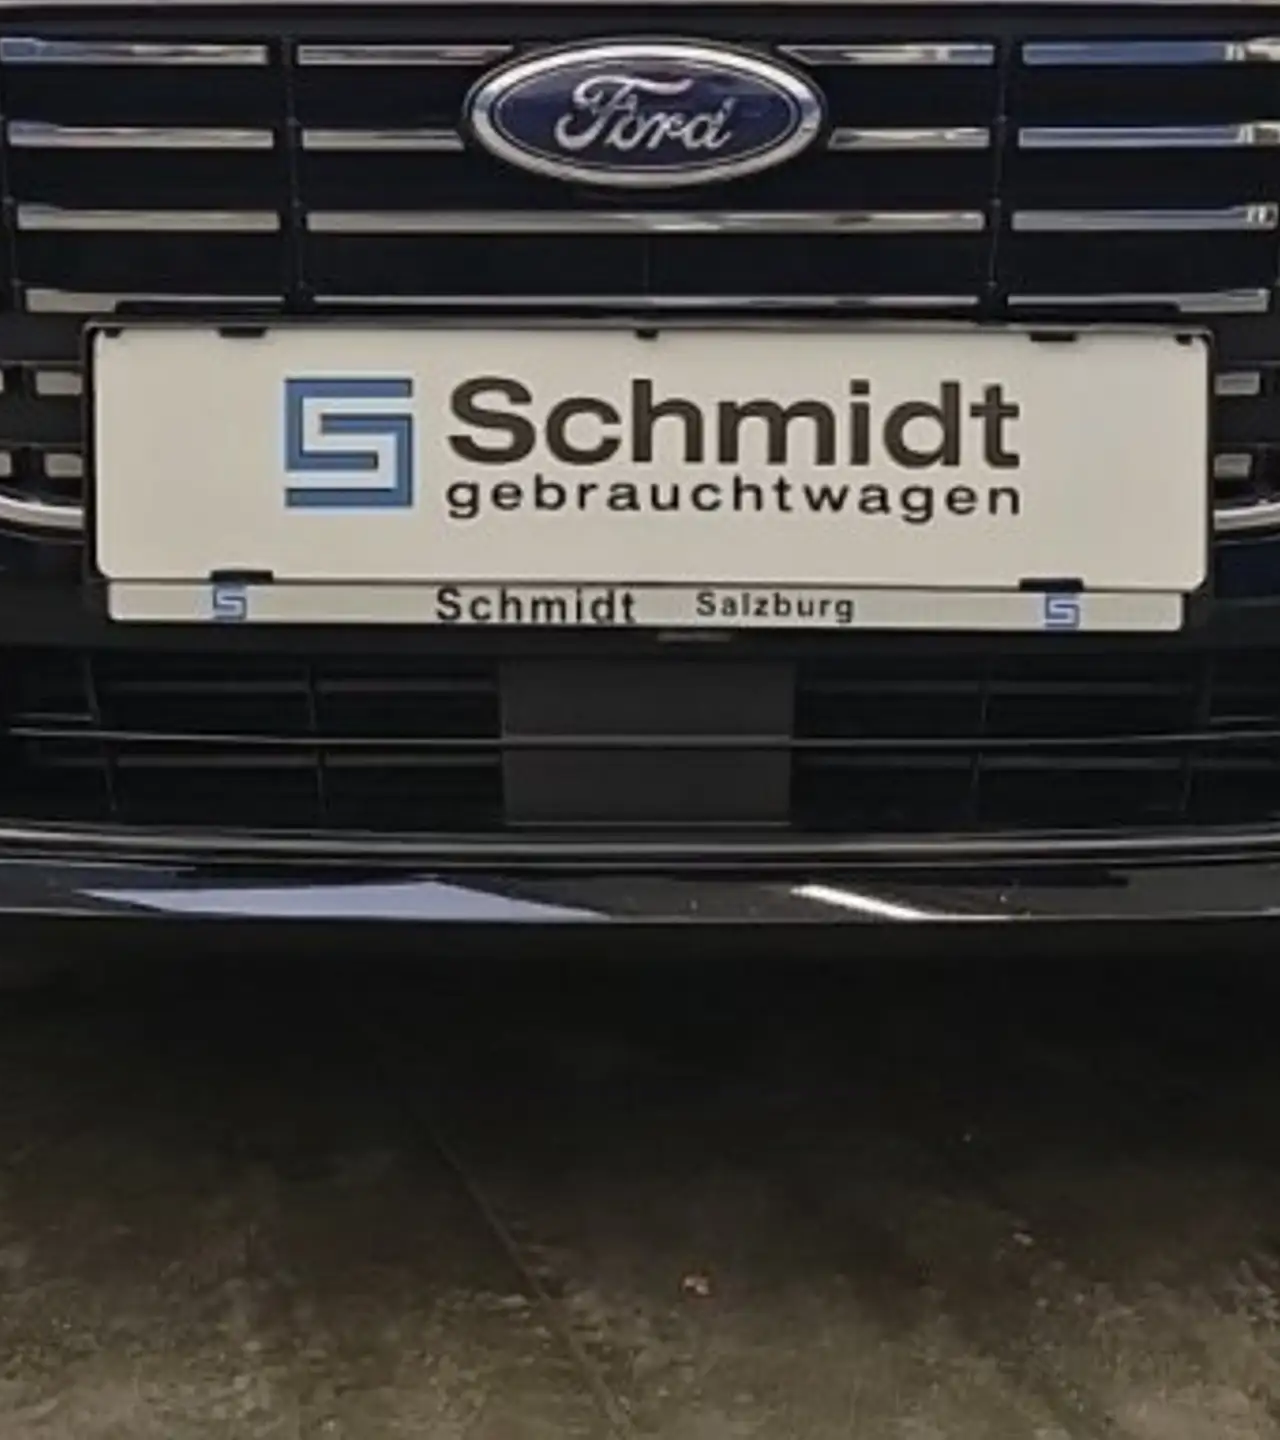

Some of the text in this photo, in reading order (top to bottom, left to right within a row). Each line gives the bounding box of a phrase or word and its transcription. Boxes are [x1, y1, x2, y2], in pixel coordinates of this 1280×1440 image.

[554, 74, 732, 152] Ford
[447, 376, 1020, 469] Schmidt
[445, 474, 1021, 524] gebrauchtwagen
[436, 587, 856, 623] Schmidt Salzburg
